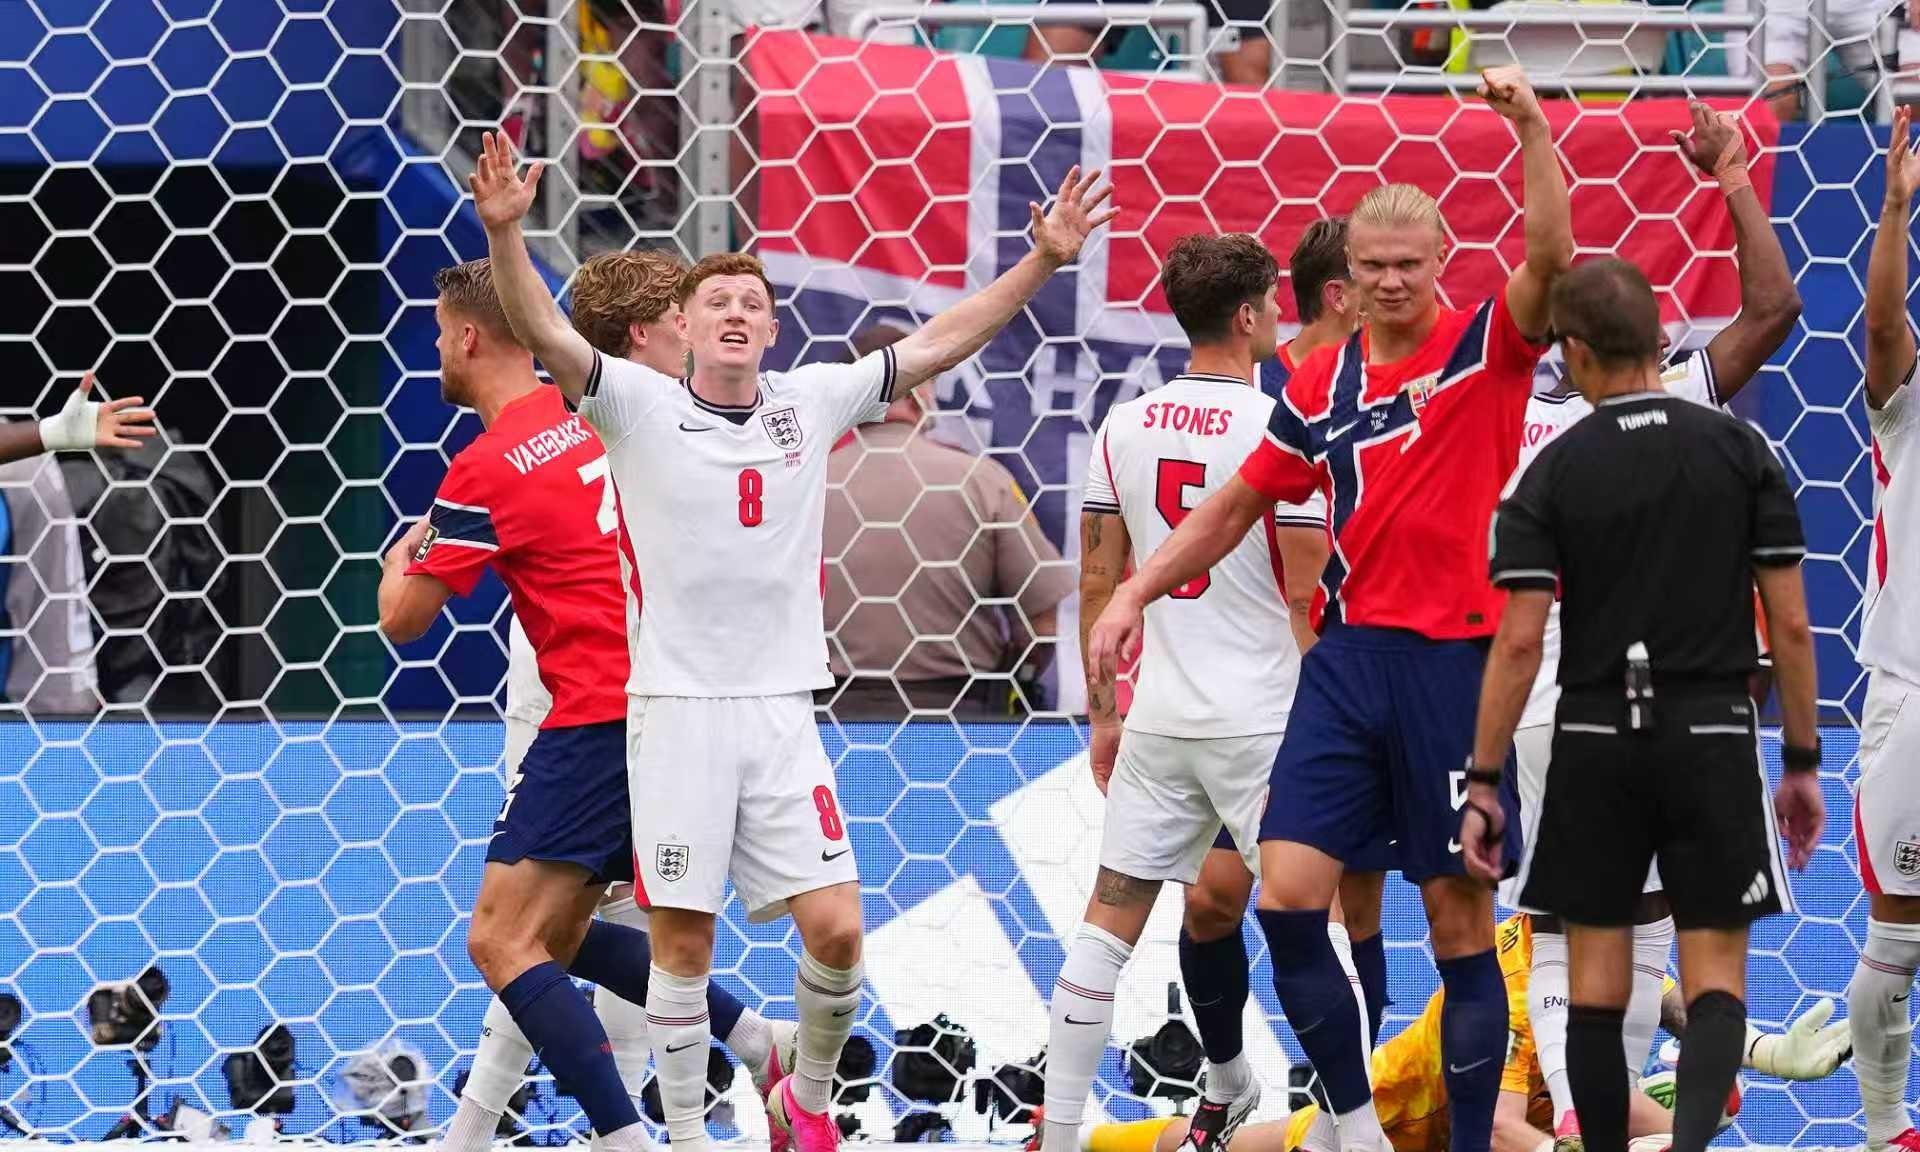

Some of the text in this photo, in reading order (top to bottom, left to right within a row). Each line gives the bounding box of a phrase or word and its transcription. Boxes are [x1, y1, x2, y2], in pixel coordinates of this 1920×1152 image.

[1143, 402, 1233, 436] STONES
[738, 468, 763, 528] 8
[812, 784, 844, 841] 8
